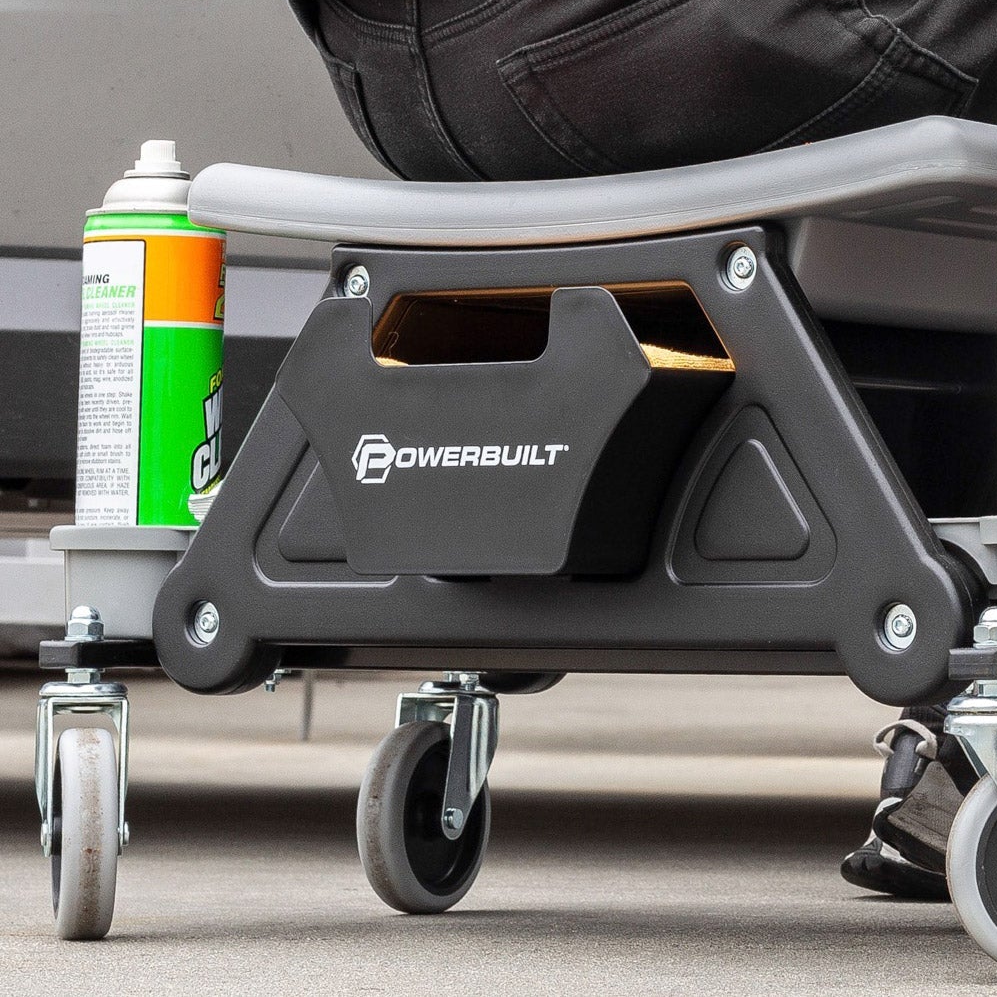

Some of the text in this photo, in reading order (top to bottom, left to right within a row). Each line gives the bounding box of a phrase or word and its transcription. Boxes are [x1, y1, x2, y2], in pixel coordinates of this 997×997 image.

[82, 274, 110, 285] AMING
[86, 285, 136, 300] CLEANER
[210, 370, 223, 394] FO
[192, 427, 221, 490] CL
[352, 434, 564, 483] POWERBUILT
